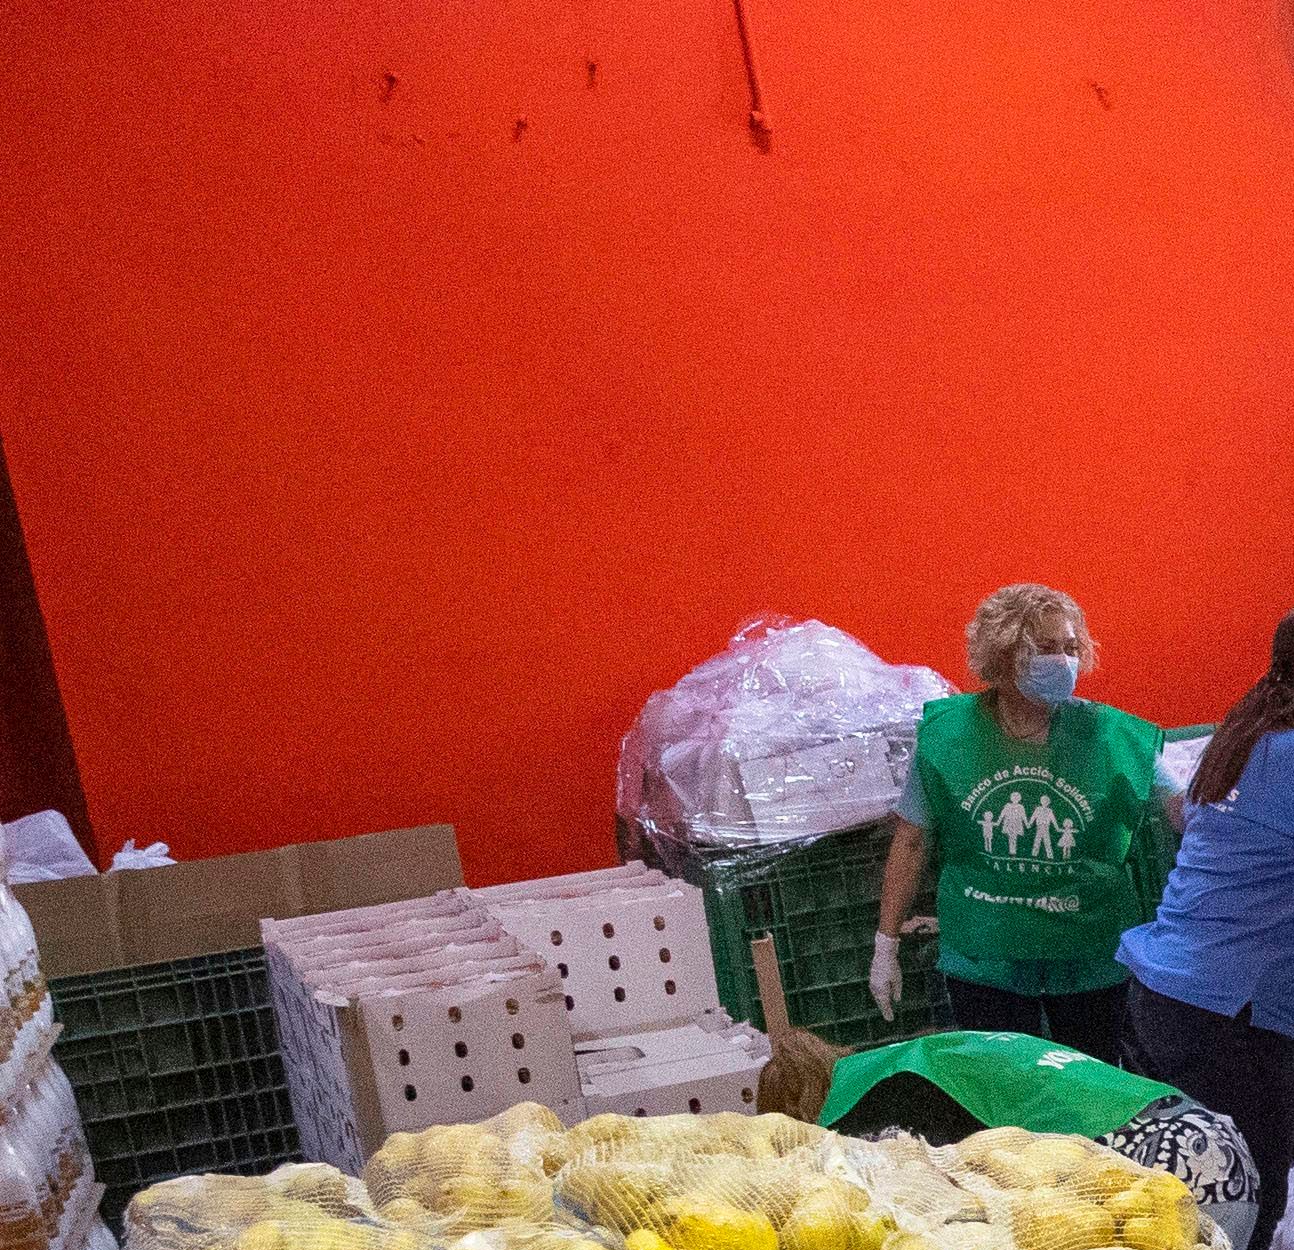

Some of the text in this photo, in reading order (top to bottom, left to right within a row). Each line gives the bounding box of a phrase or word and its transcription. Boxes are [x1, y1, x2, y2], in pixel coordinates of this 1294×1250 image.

[961, 778, 992, 812] Banco
[994, 769, 1009, 782] de
[986, 861, 1076, 875] ALENCIA
